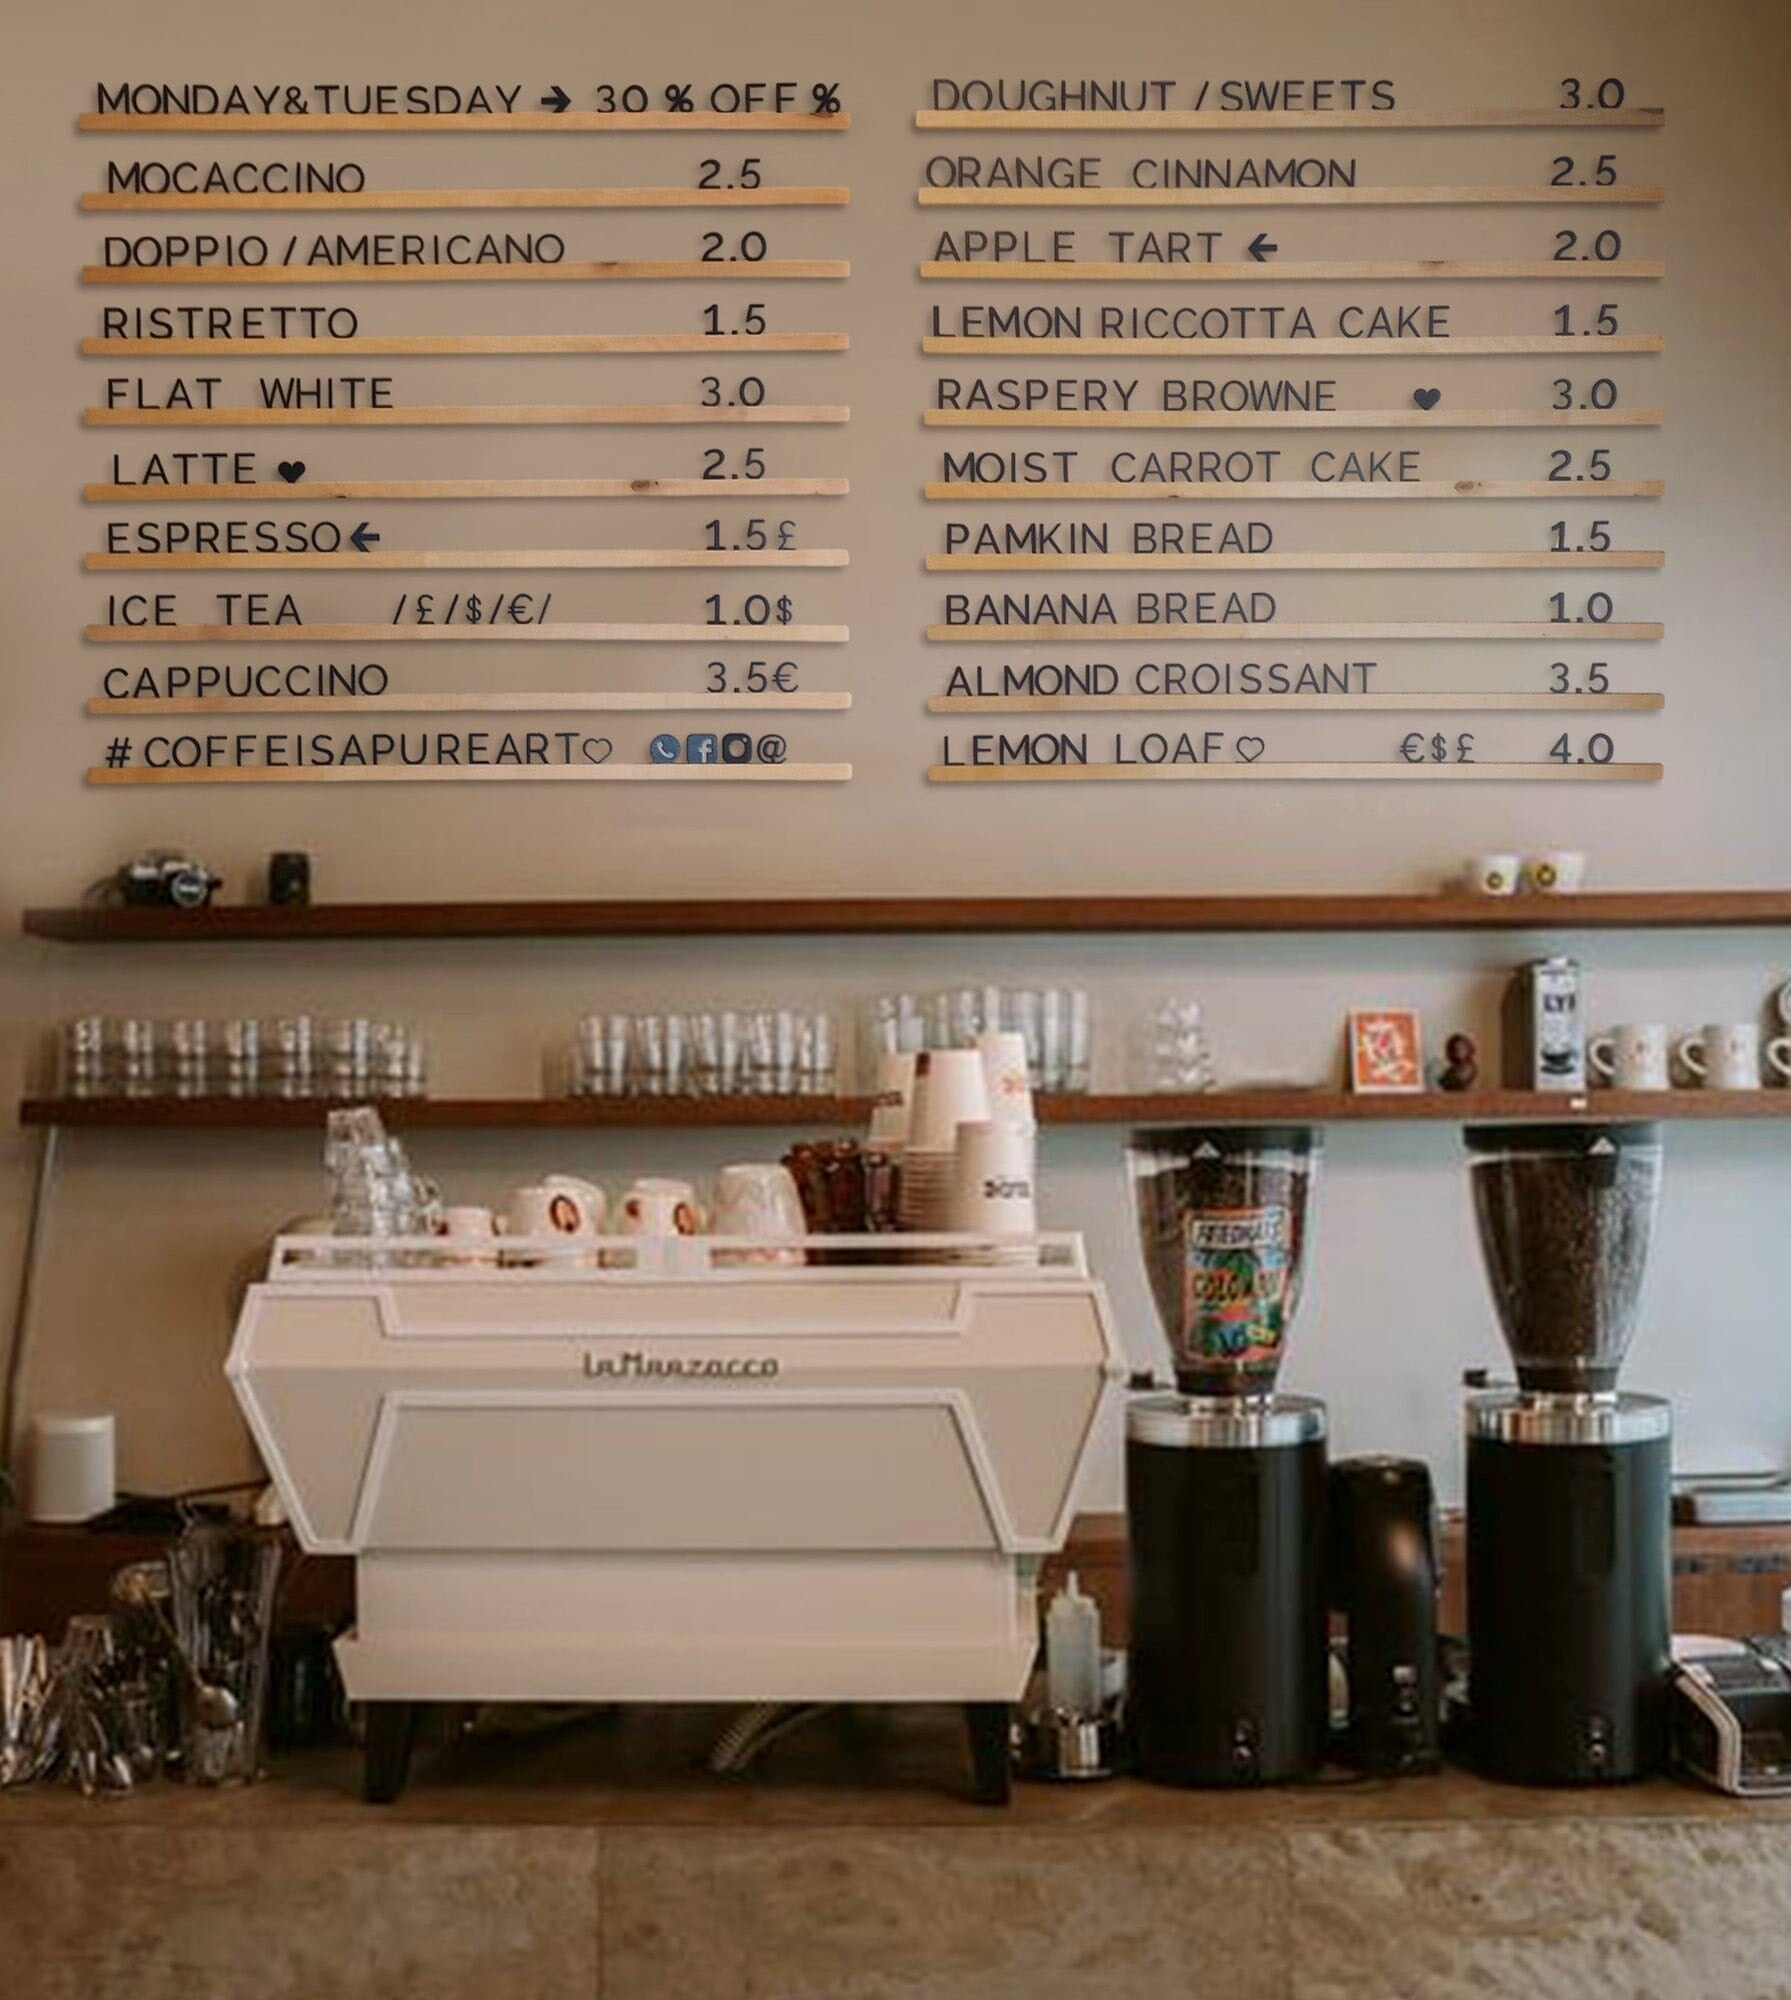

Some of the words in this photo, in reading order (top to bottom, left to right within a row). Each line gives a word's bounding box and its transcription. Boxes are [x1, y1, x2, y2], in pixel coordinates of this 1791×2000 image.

[97, 82, 522, 116] MONDAY&TUESDAY
[596, 83, 649, 114] 30
[709, 82, 798, 114] OFF
[809, 82, 841, 115] %
[933, 79, 1177, 111] DOUGHNUT
[1220, 79, 1396, 112] SWEETS
[1559, 77, 1626, 110] 3.0
[107, 160, 365, 195] MOCACCINO
[697, 158, 761, 190] 2.5
[925, 156, 1101, 189] ORANGE
[1132, 158, 1356, 189] CINNAMON
[1549, 154, 1618, 187] 2.5
[104, 234, 268, 269] DOPPIO
[306, 233, 565, 267] AMERICANO
[701, 230, 767, 263] 2.0
[934, 230, 1076, 263] APPLE
[1108, 231, 1223, 263] TART
[1553, 229, 1622, 262] 2.0
[103, 306, 358, 340] RISTRETTO
[703, 303, 766, 336] 1.5
[932, 305, 1081, 339] LEMON
[1101, 306, 1316, 339] RICCOTTA
[1339, 305, 1450, 338] CAKE
[1554, 303, 1619, 337] 1.5
[107, 377, 222, 410] FLAT
[259, 377, 393, 410] WHITE
[701, 376, 765, 408] 3.0
[937, 378, 1139, 411] RASPERY
[1163, 379, 1336, 412] BROWNE
[1552, 378, 1618, 410] 3.0
[113, 452, 257, 486] LATTE
[702, 447, 765, 480] 2.5
[943, 451, 1078, 483] MOIST
[1111, 451, 1281, 483] CARROT
[1311, 451, 1420, 482] CAKE
[1548, 449, 1611, 482] 2.5
[107, 520, 341, 555] ESPRESSO
[946, 522, 1108, 555] PAMKIN
[1134, 522, 1273, 554] BREAD
[1550, 520, 1611, 553] 1.5
[108, 594, 177, 627] ICE
[215, 593, 303, 627] TEA
[945, 593, 1118, 626] BANANA
[1137, 592, 1276, 625] BREAD
[1550, 592, 1613, 624] 1.0
[103, 663, 389, 700] CAPPUCCINO
[706, 661, 799, 695] 3.5€
[946, 664, 1119, 697] ALMOND
[1135, 662, 1377, 695] CROISSANT
[1550, 662, 1609, 695] 3.5
[943, 733, 1087, 767] LEMON
[1116, 732, 1224, 765] LOAF
[1550, 733, 1614, 765] 4.0
